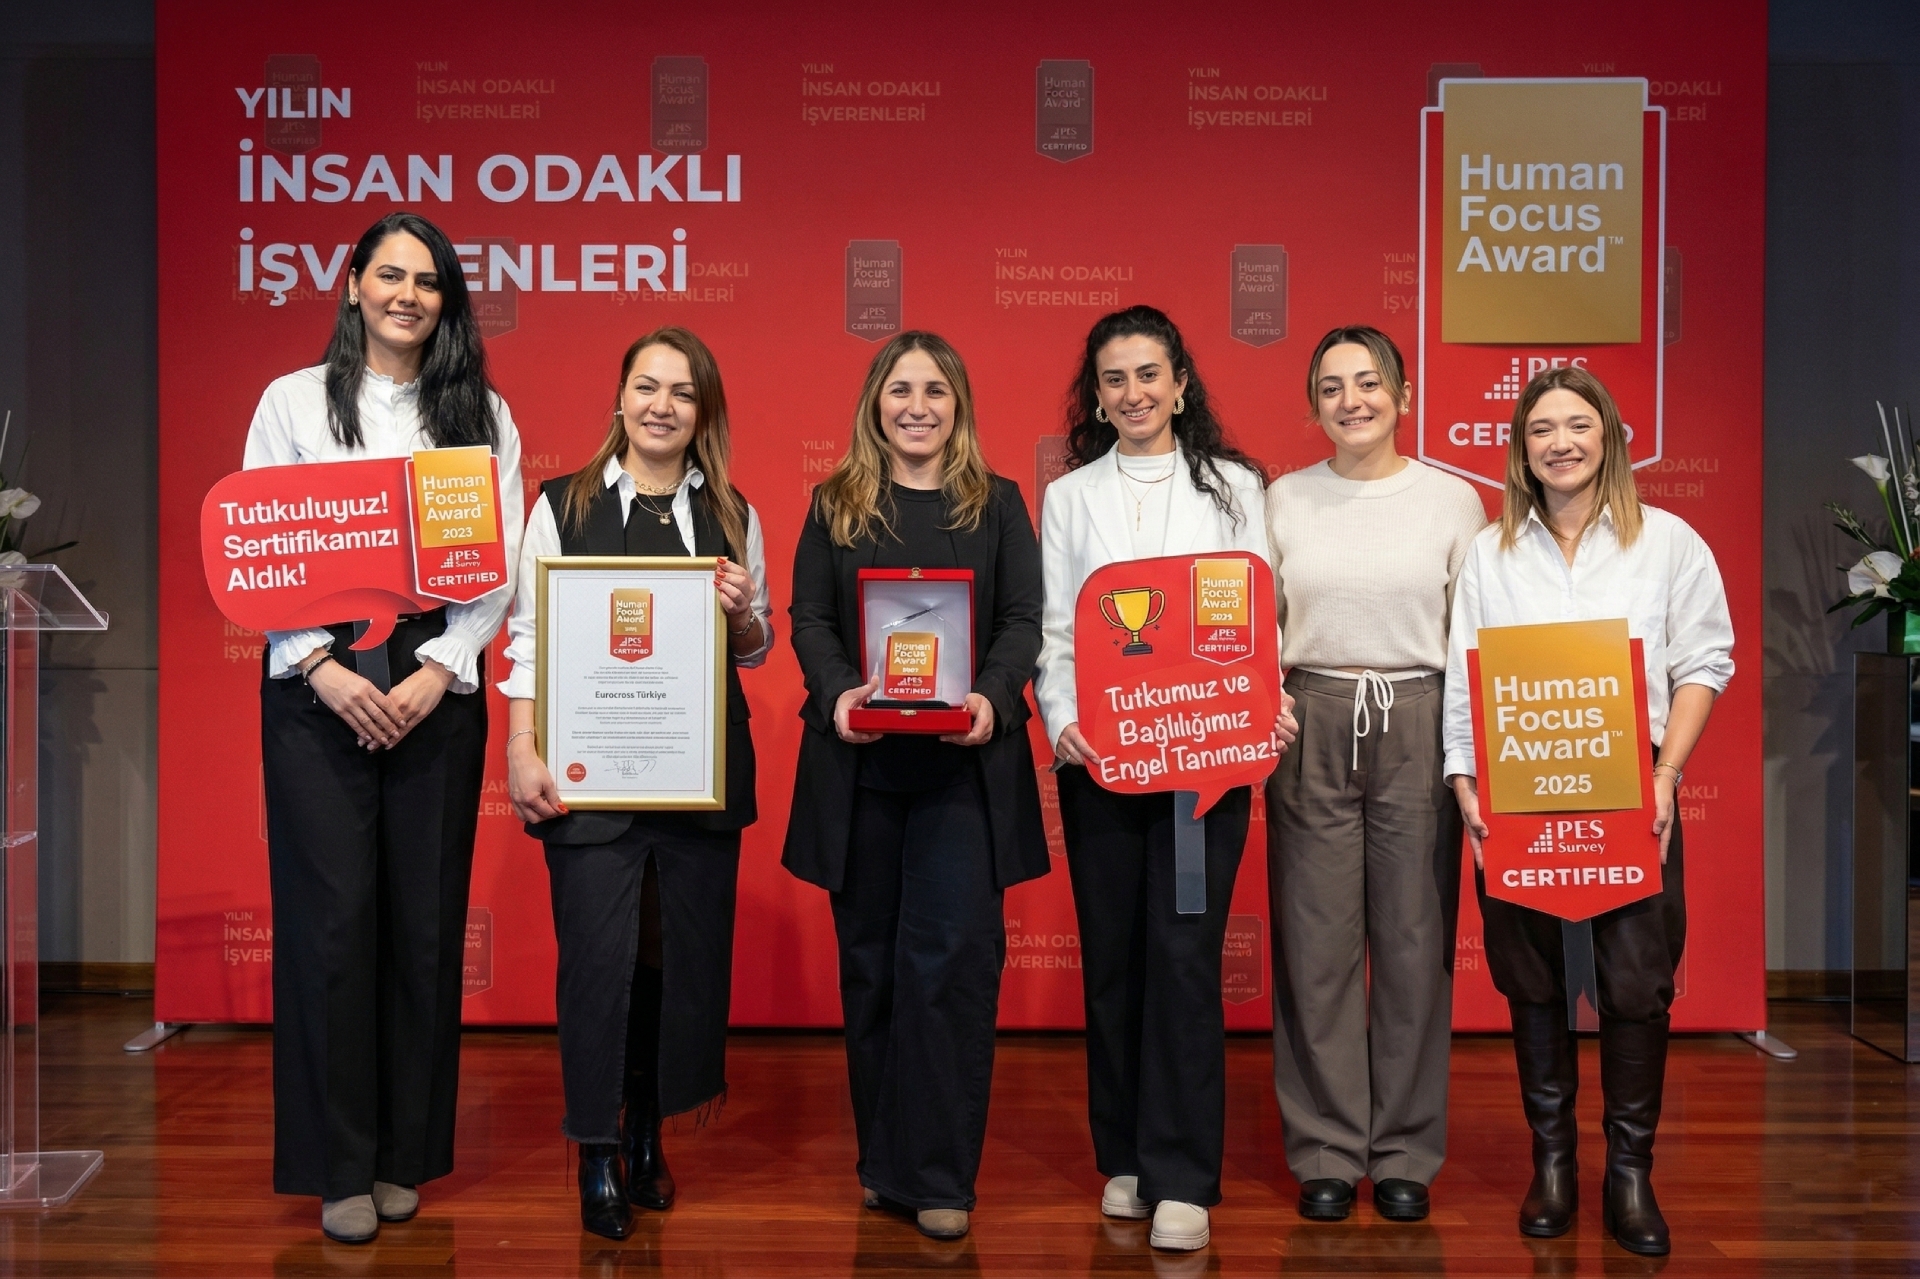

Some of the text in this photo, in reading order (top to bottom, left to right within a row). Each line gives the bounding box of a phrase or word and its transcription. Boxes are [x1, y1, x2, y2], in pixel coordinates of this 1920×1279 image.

[416, 61, 448, 72] YILIN
[801, 63, 834, 74] YILIN
[1188, 67, 1220, 78] YILIN
[416, 76, 555, 95] İNSAN ODAKLI
[802, 77, 940, 96] İNSAN ODAKLI
[1188, 81, 1327, 101] İNSAN ODAKLI
[1649, 81, 1722, 96] ODAKLI
[235, 87, 352, 118] YILIN
[416, 101, 541, 122] İŞVERENLERİ
[802, 103, 926, 127] İŞVERENLERİ
[1188, 106, 1312, 130] İŞVERENLERİ
[239, 138, 741, 203] İNSAN ODAKLI
[1461, 153, 1624, 190] Human
[1461, 195, 1601, 232] Focus
[995, 248, 1028, 258] YILIN
[1383, 253, 1416, 263] YILIN
[853, 257, 894, 268] Human
[1238, 262, 1279, 273] Human
[853, 267, 889, 278] Focus
[995, 261, 1133, 281] İNSAN ODAKLI
[1238, 272, 1273, 283] Focus
[995, 286, 1119, 309] İŞVERENLERİ
[801, 440, 835, 450] YILIN
[422, 475, 486, 490] Human
[424, 491, 479, 506] Focus
[442, 526, 473, 539] 2023
[454, 549, 480, 561] PES
[226, 562, 307, 592] Aldık!
[427, 571, 499, 587] CERTIFIED
[1201, 577, 1244, 588] Human
[1201, 588, 1238, 598] Focus
[1219, 628, 1237, 637] PES
[1198, 644, 1248, 652] CERTIFIED
[595, 690, 667, 701] Eurocross Türkiye
[1105, 675, 1251, 713] Tutkumuz ve
[1494, 675, 1620, 703] Human
[1496, 705, 1605, 733] Focus
[1118, 710, 1252, 748] Bağlılığımız
[1100, 731, 1279, 785] Engel Tanımaz!
[1533, 774, 1593, 795] 2025
[1556, 819, 1605, 840] PES
[1558, 841, 1606, 855] Survey
[1502, 866, 1645, 888] CERTIFIED
[223, 911, 253, 921] YILIN
